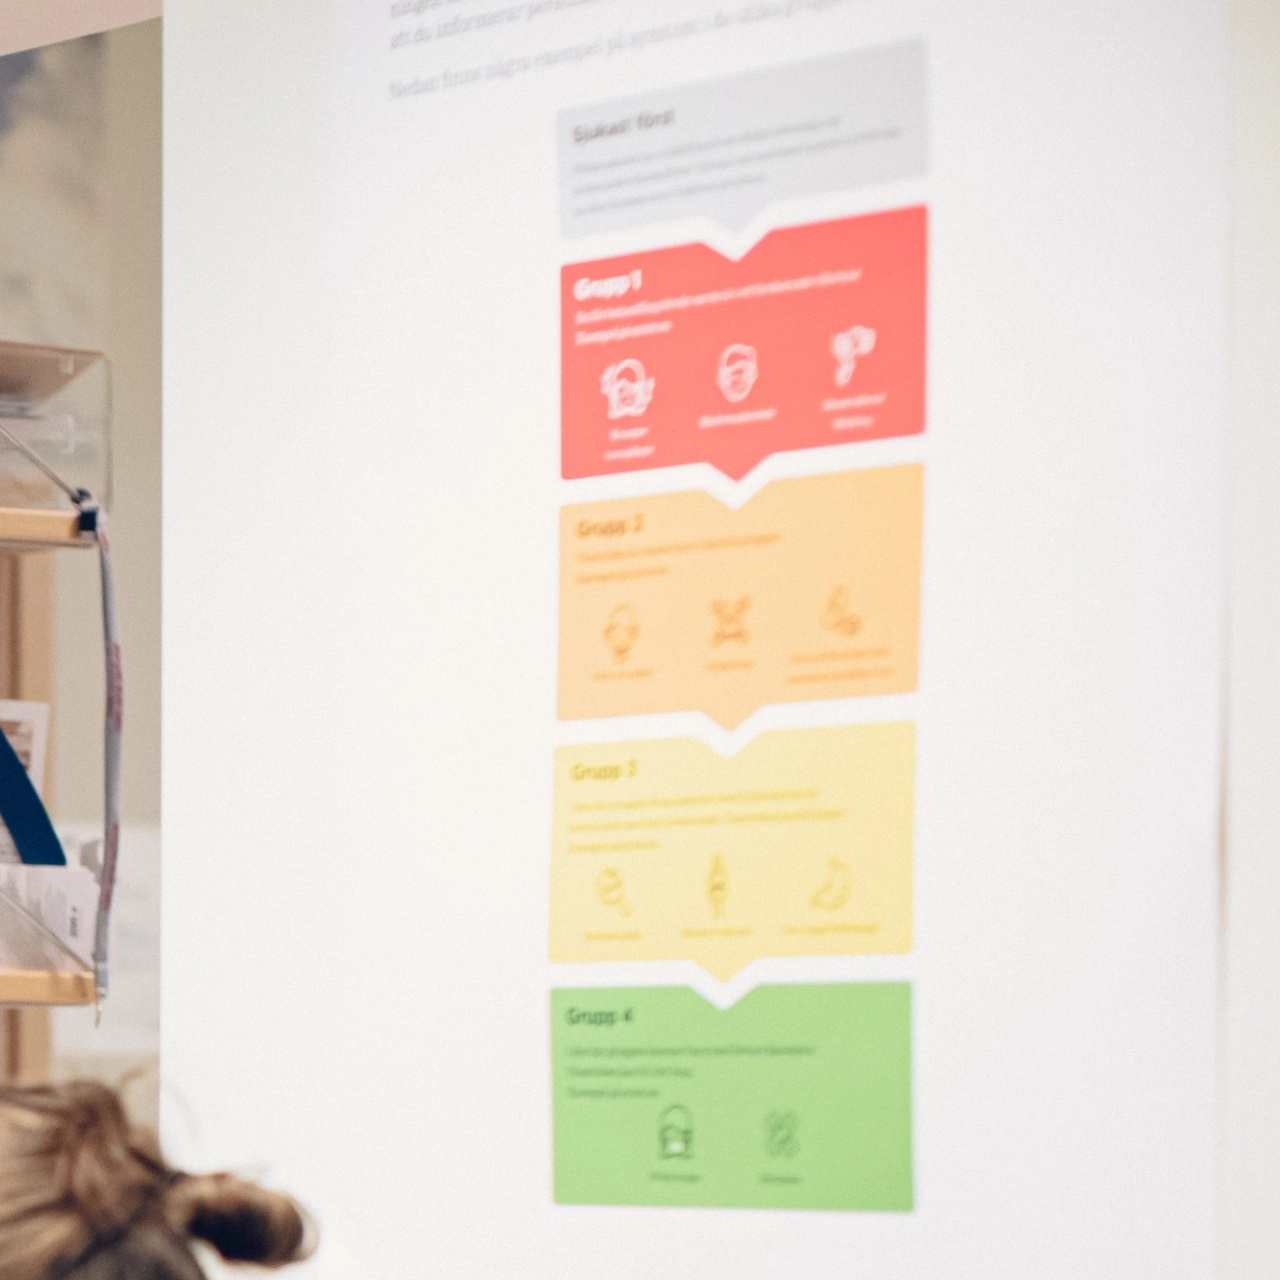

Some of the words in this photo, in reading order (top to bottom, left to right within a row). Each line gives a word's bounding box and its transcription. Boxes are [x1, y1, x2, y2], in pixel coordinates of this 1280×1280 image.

[573, 276, 631, 301] Grupp
[631, 269, 642, 291] 1
[567, 1007, 616, 1026] Grupp
